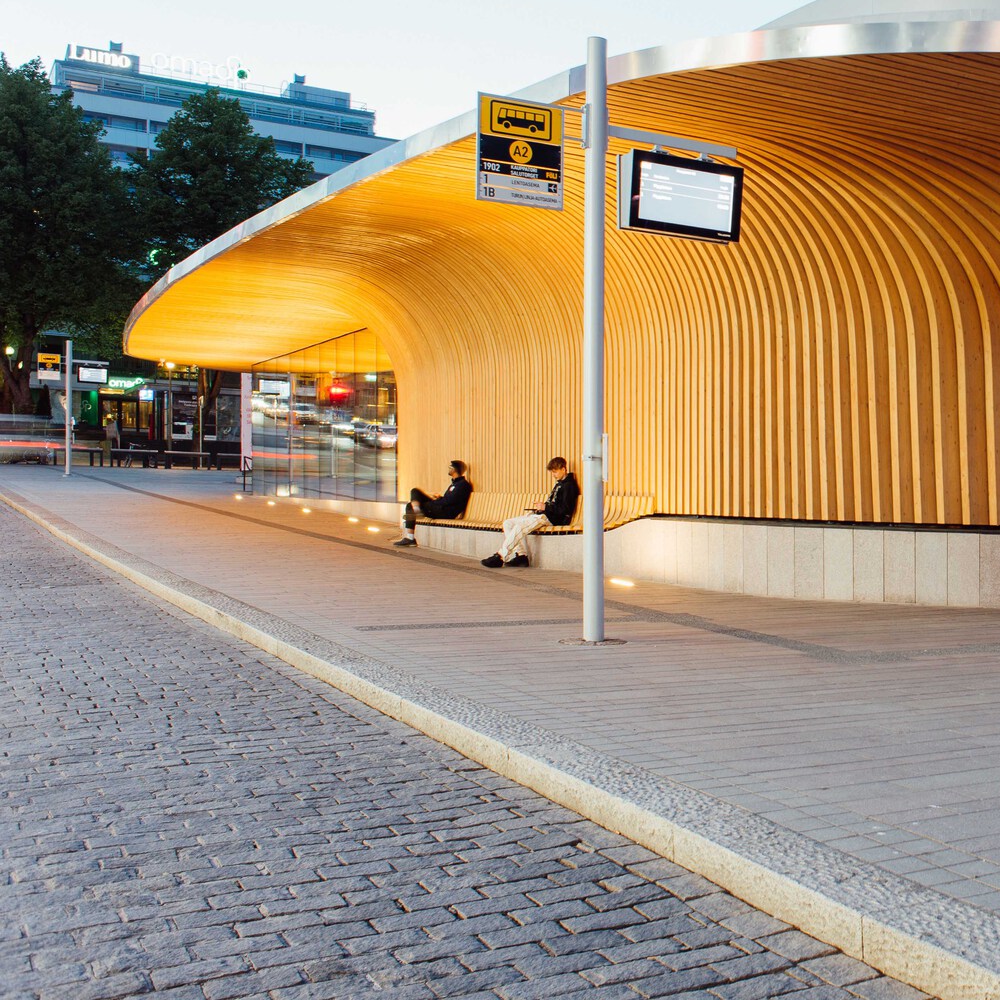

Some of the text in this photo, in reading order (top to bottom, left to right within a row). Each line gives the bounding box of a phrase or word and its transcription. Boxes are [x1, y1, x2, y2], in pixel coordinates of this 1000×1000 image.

[69, 41, 131, 68] Lumo
[513, 145, 528, 158] A2
[483, 162, 500, 172] 1902
[484, 174, 488, 184] 1
[483, 187, 496, 198] 1B
